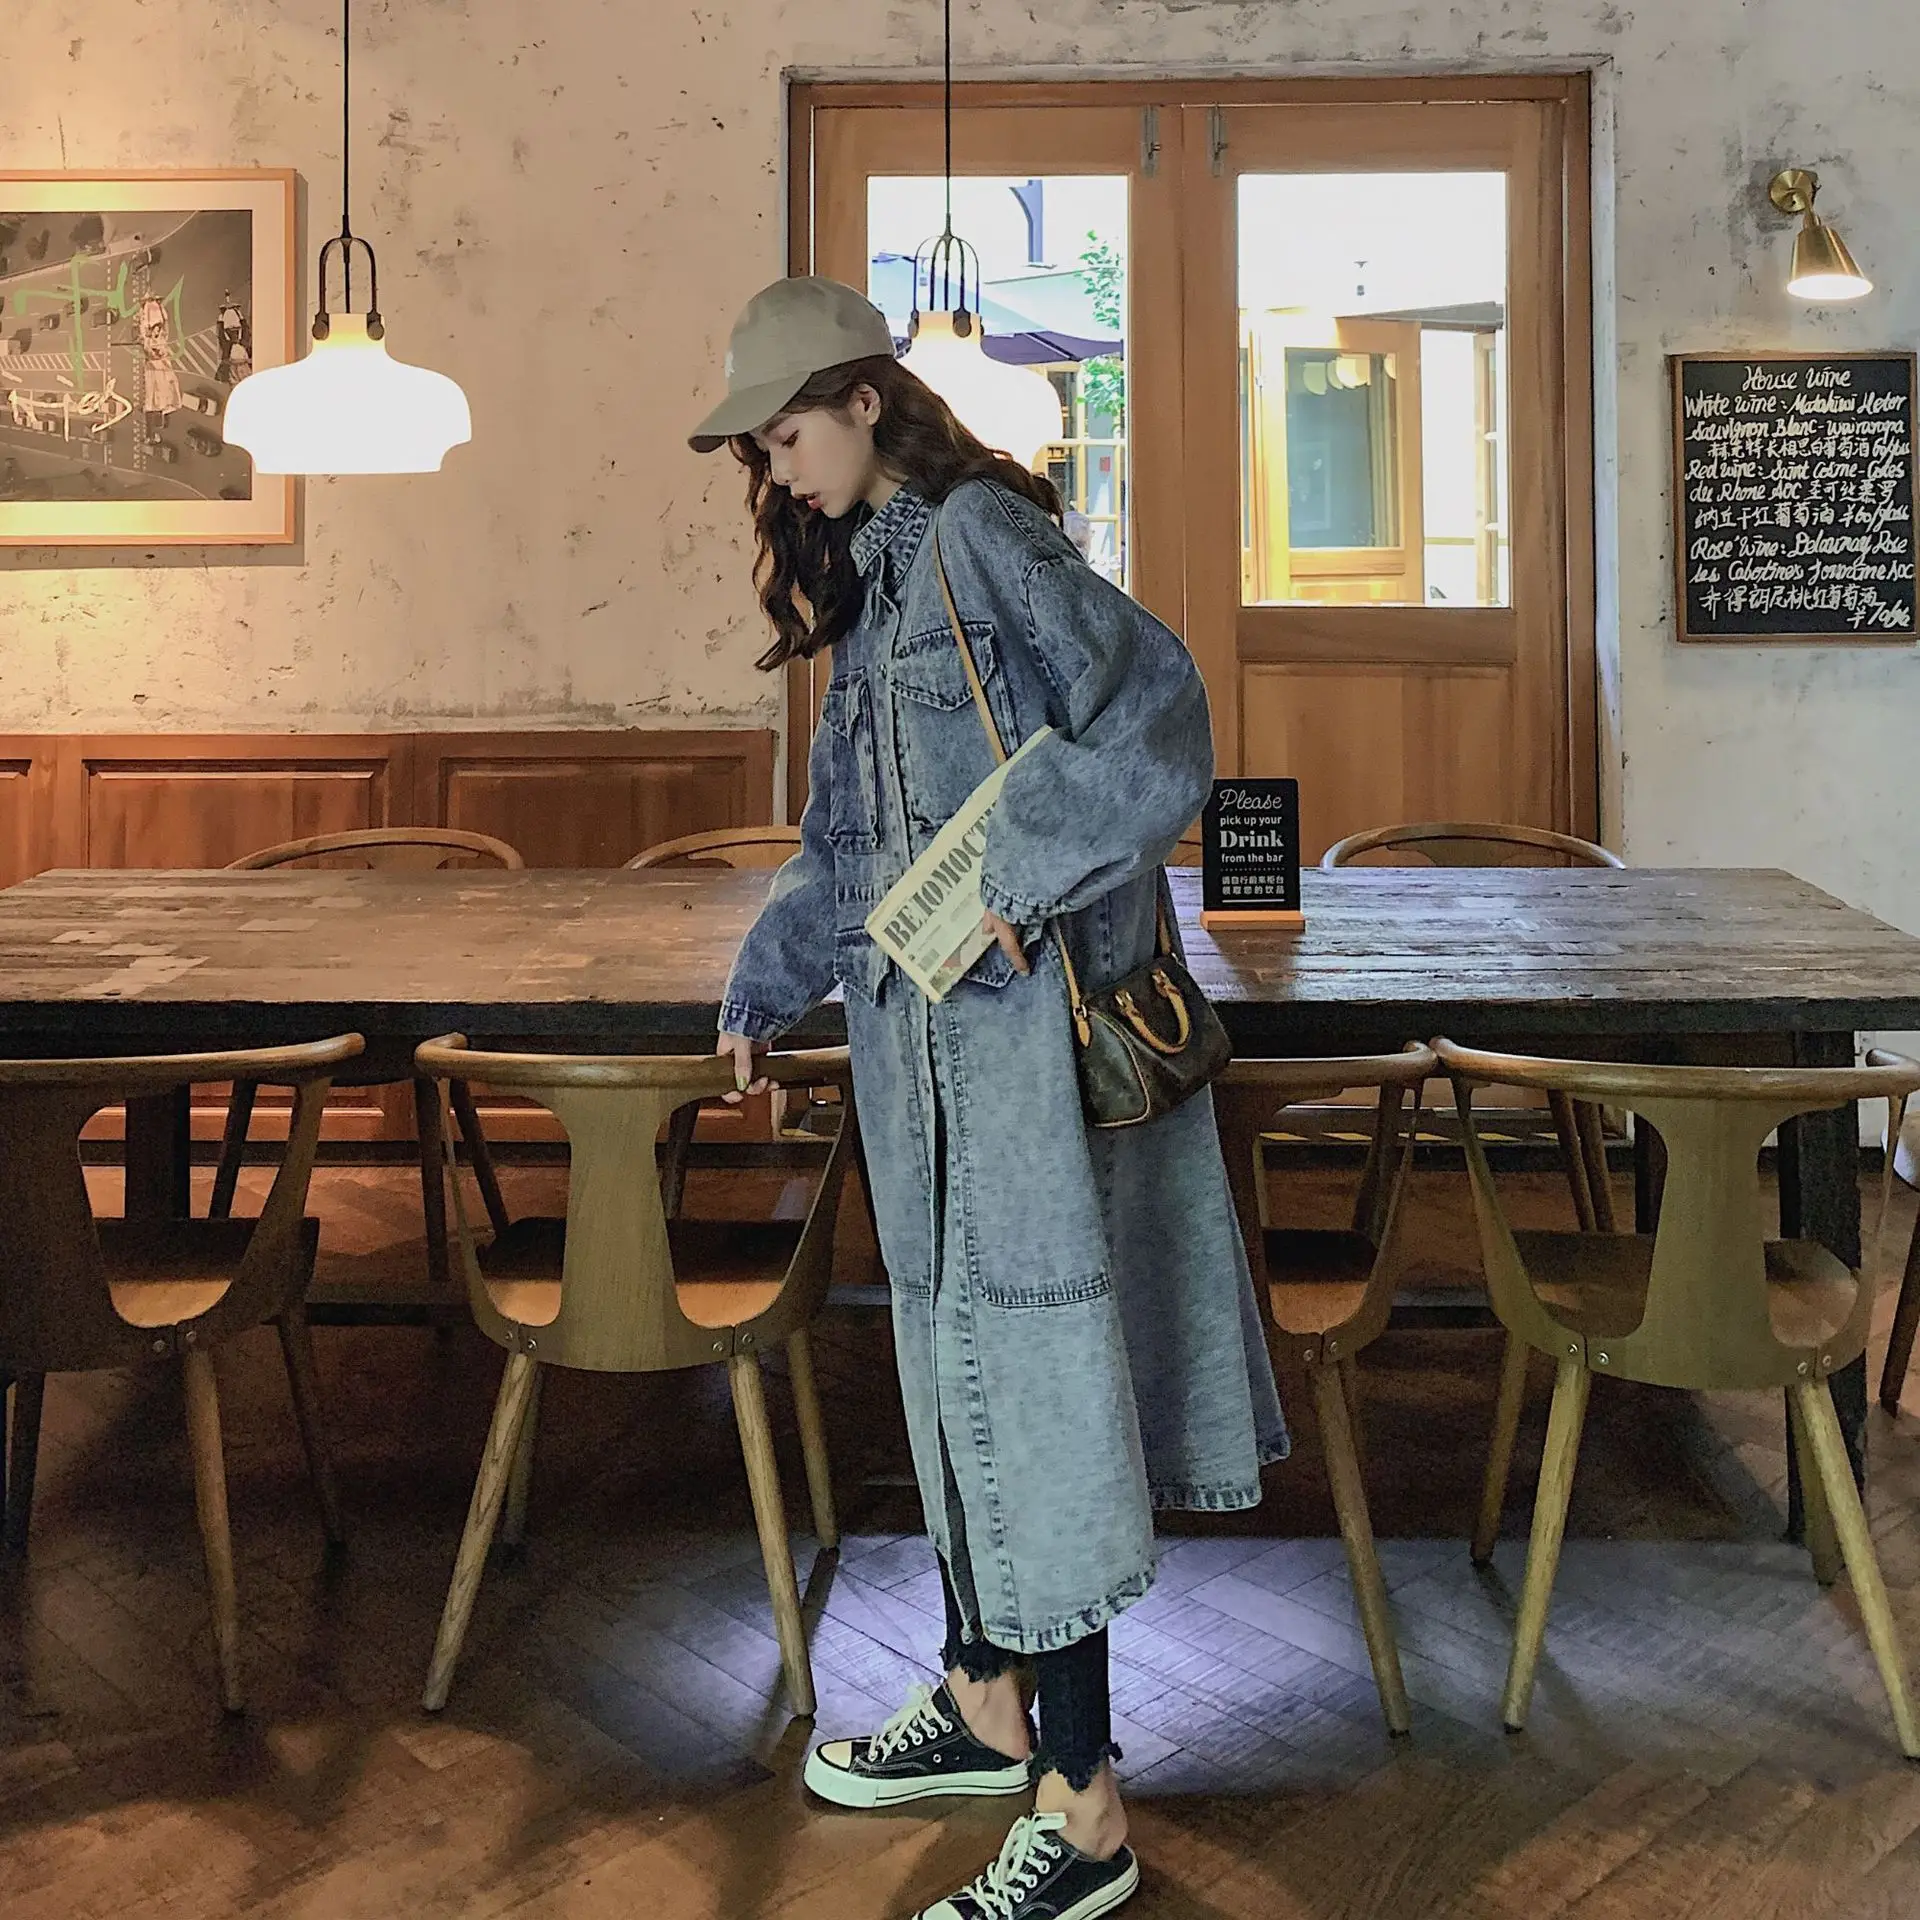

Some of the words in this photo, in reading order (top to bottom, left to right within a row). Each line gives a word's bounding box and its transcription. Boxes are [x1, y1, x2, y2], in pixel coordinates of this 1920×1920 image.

[1742, 366, 1798, 391] House
[1685, 389, 1731, 418] White
[1685, 456, 1719, 480] Red
[1762, 459, 1810, 481] Saint
[1690, 480, 1714, 503] du
[1218, 788, 1283, 812] Please
[1220, 815, 1242, 827] pick
[1243, 817, 1257, 826] up
[1258, 815, 1282, 827] your
[1219, 829, 1284, 848] Drink
[1221, 853, 1246, 863] from
[1248, 853, 1265, 863] the
[1266, 852, 1284, 863] bar
